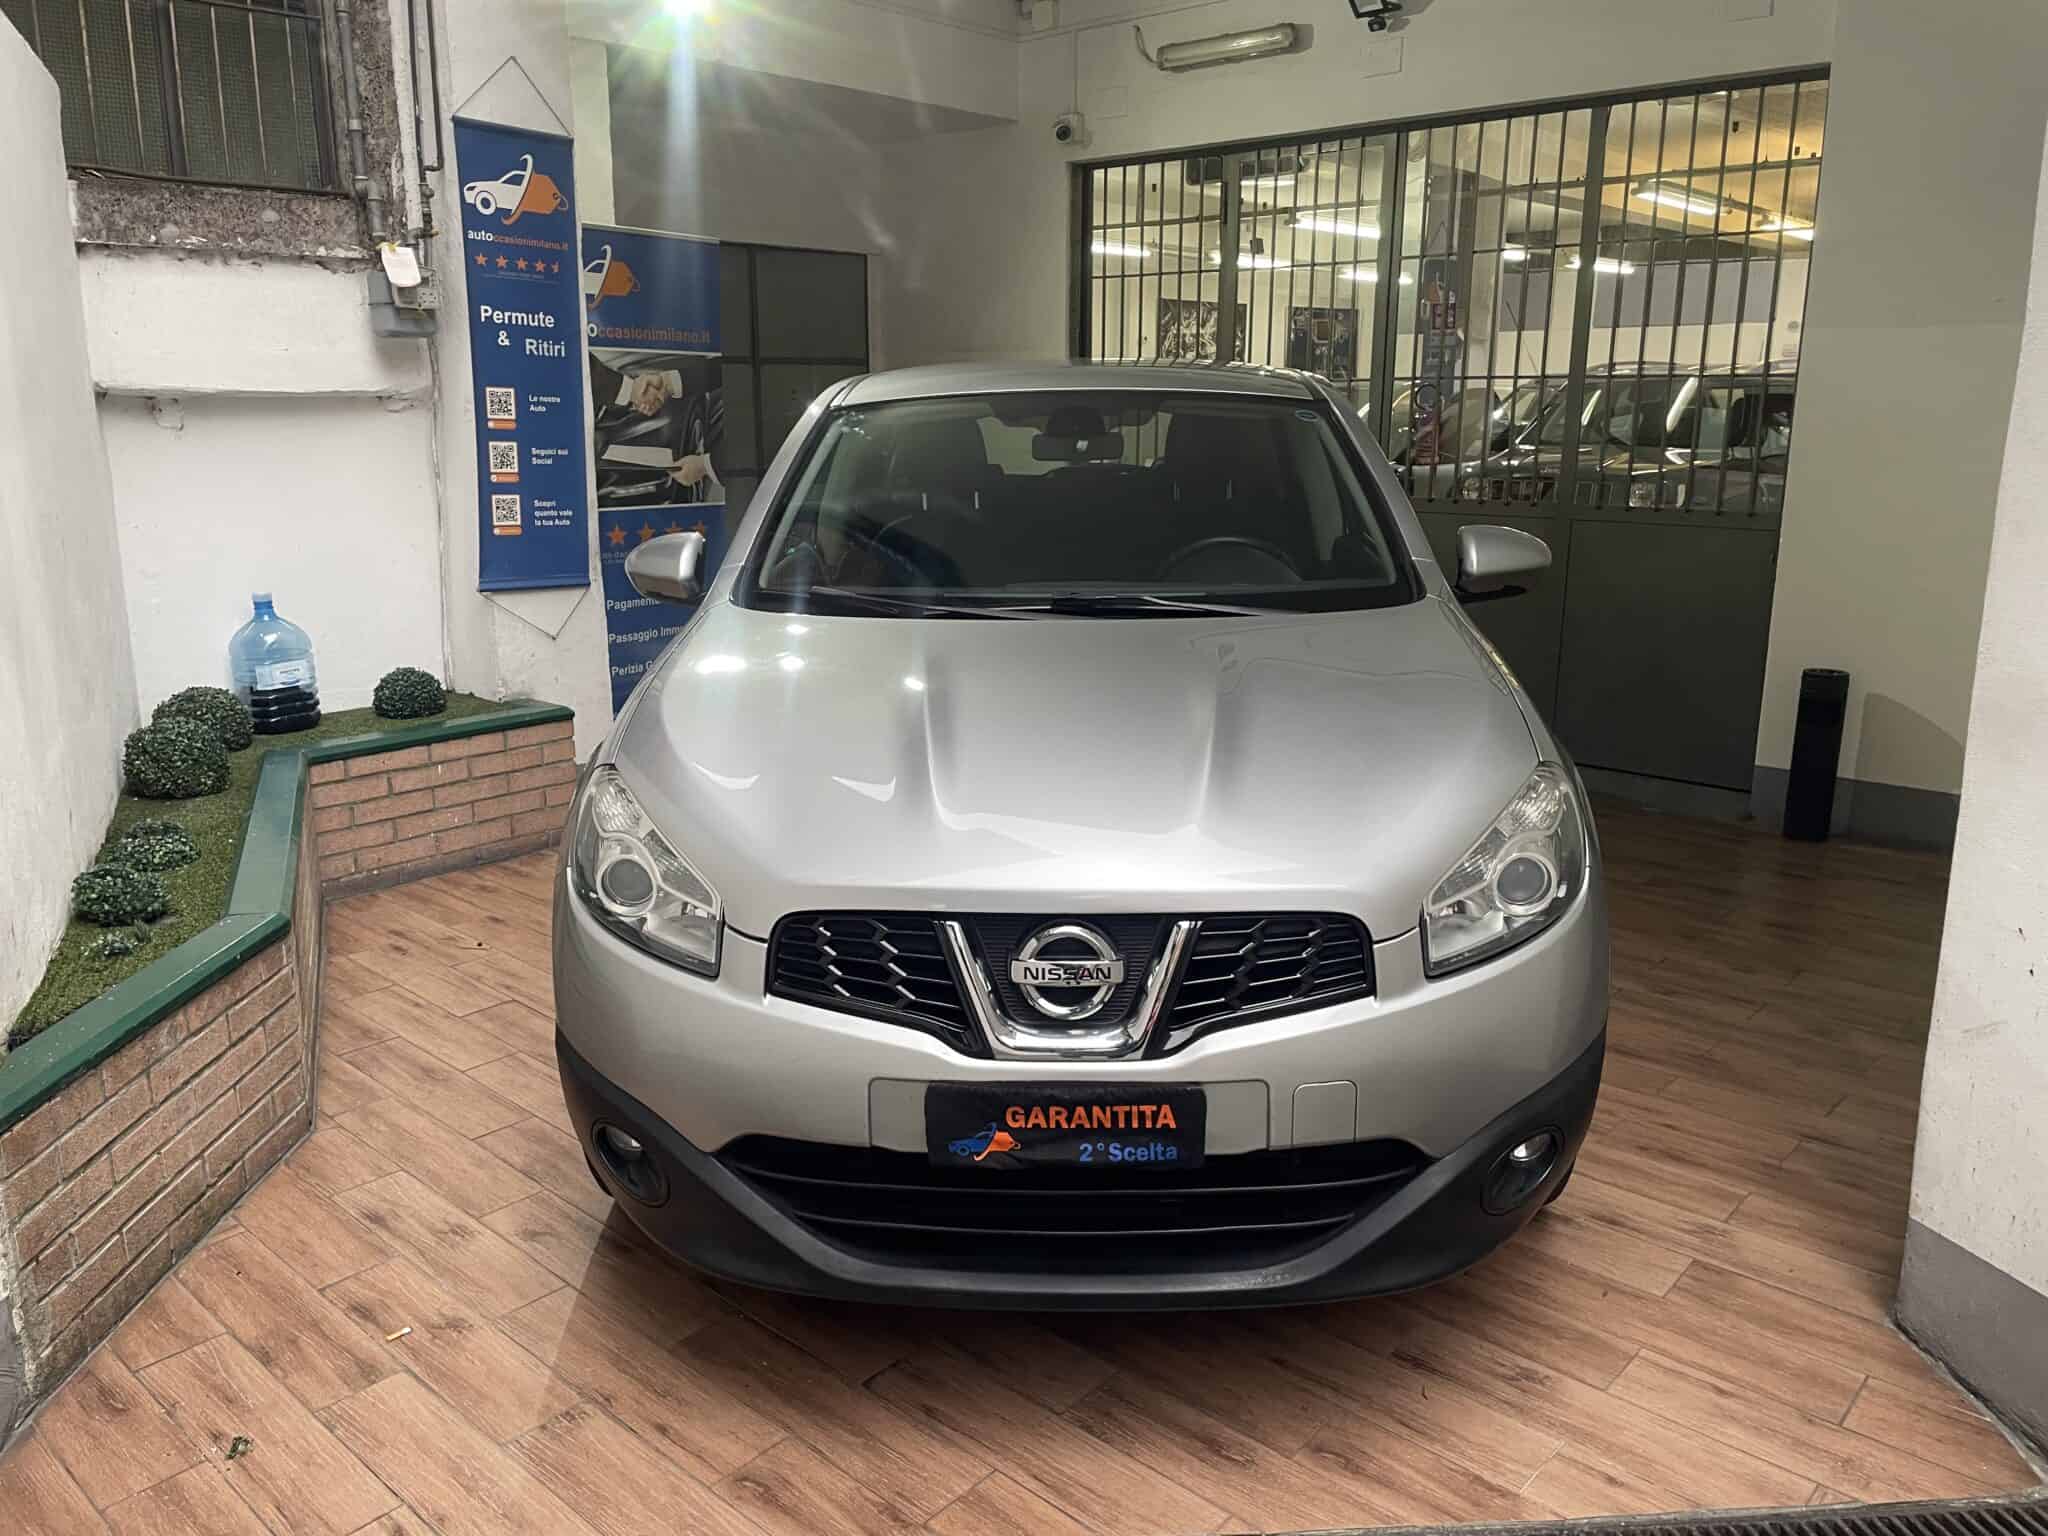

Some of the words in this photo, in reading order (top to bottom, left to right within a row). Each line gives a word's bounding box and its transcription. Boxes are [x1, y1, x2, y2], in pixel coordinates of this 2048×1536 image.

[480, 305, 555, 328] Permute
[497, 330, 511, 347] &
[525, 338, 565, 358] Ritiri
[529, 404, 546, 412] Auto
[554, 517, 571, 526] Auto
[608, 627, 658, 645] Passaggio
[1023, 966, 1112, 982] NISSAN
[1005, 1103, 1178, 1130] GARANTITA
